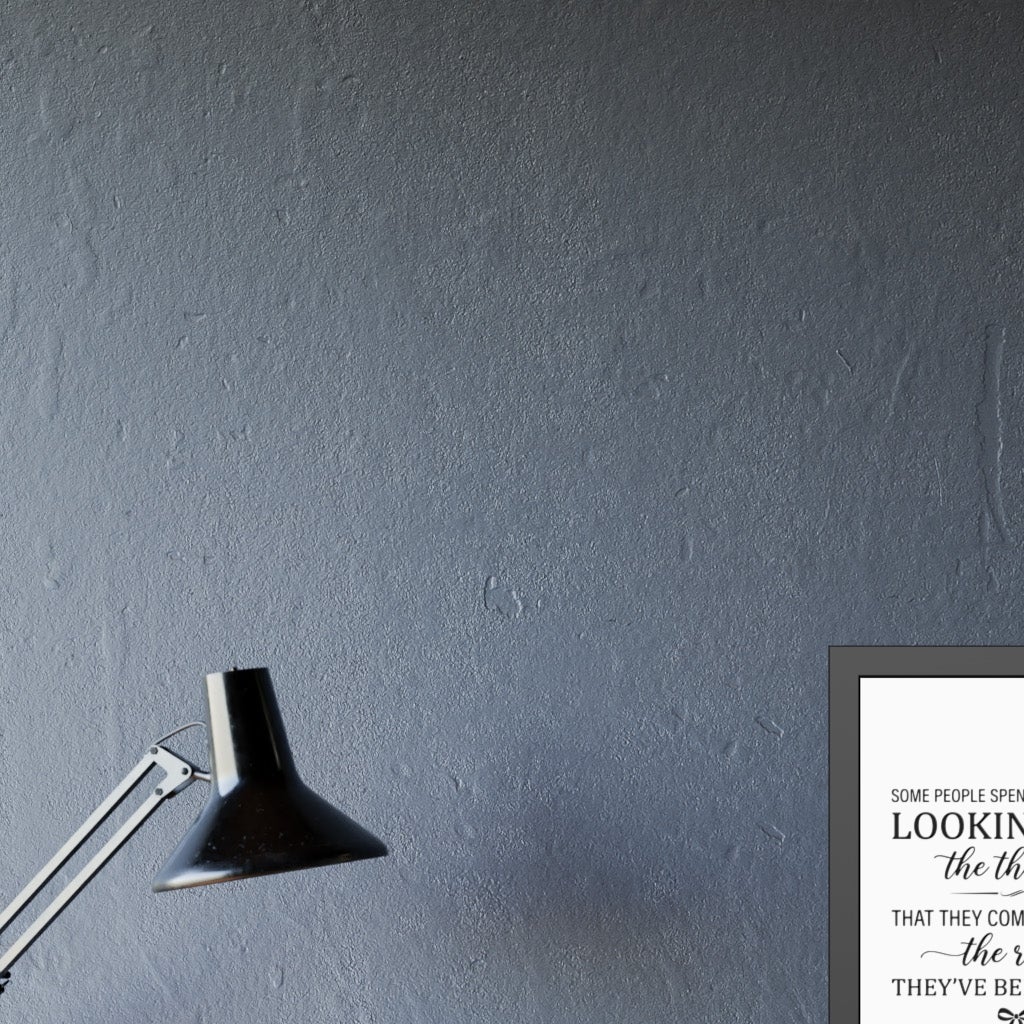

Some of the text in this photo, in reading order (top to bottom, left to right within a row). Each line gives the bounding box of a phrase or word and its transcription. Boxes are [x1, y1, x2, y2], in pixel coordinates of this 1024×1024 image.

[891, 788, 930, 803] SOME
[934, 788, 986, 803] PEOPLE
[934, 846, 990, 881] the
[891, 909, 934, 927] THAT
[939, 909, 983, 927] THEY
[920, 932, 1008, 967] the
[891, 977, 987, 997] THEY’VE
